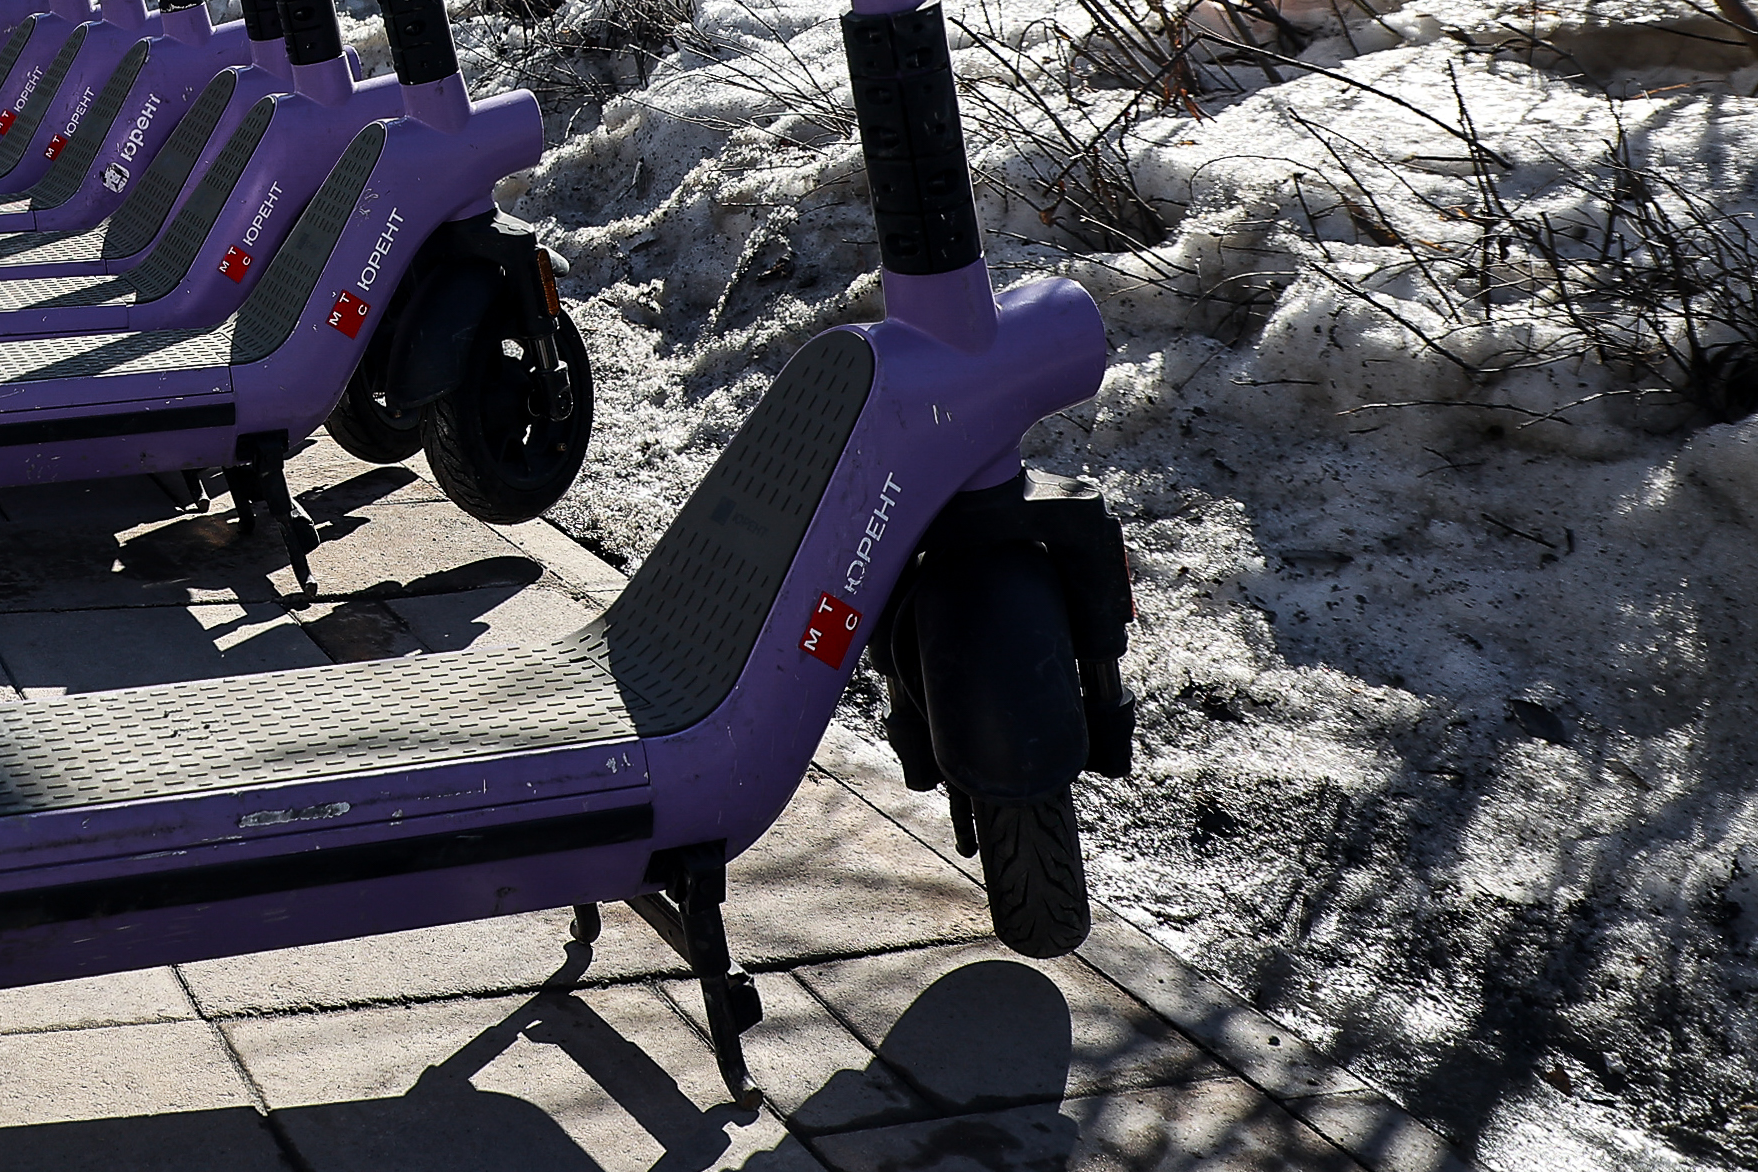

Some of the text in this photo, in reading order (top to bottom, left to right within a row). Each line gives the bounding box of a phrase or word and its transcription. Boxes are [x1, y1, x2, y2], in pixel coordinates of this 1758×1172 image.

[13, 65, 43, 113] ЮРЕНТ
[63, 86, 95, 137] ЮРЕНТ
[243, 180, 283, 247] ЮРЕНТ
[357, 207, 405, 292] ЮРЕНТ
[844, 471, 902, 595] ЮРЕНТ
